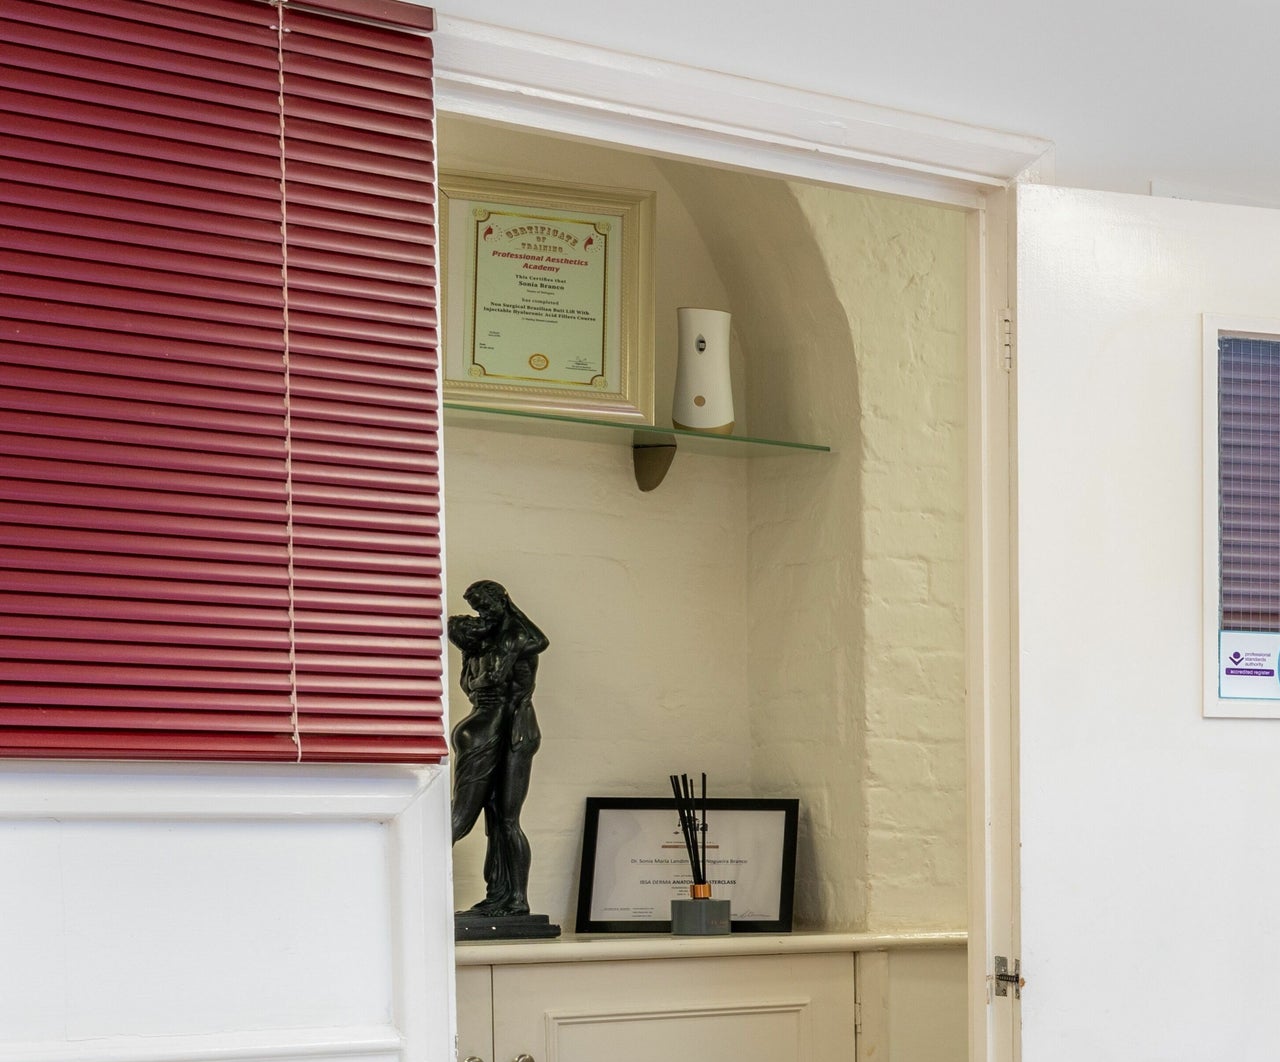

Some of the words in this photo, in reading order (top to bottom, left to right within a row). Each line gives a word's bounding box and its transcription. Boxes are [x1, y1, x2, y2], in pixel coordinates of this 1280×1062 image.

[505, 225, 579, 247] CERTIFICATE
[536, 235, 547, 243] OF
[521, 242, 563, 253] TRAINING
[492, 250, 544, 262] Professional
[545, 256, 589, 266] Aesthetics
[522, 262, 560, 273] Academy
[518, 280, 538, 288] Sonia
[529, 275, 554, 283] Certifies
[483, 306, 512, 314] Injectable
[513, 308, 543, 317] Hyaluronic
[503, 302, 526, 310] Surgical
